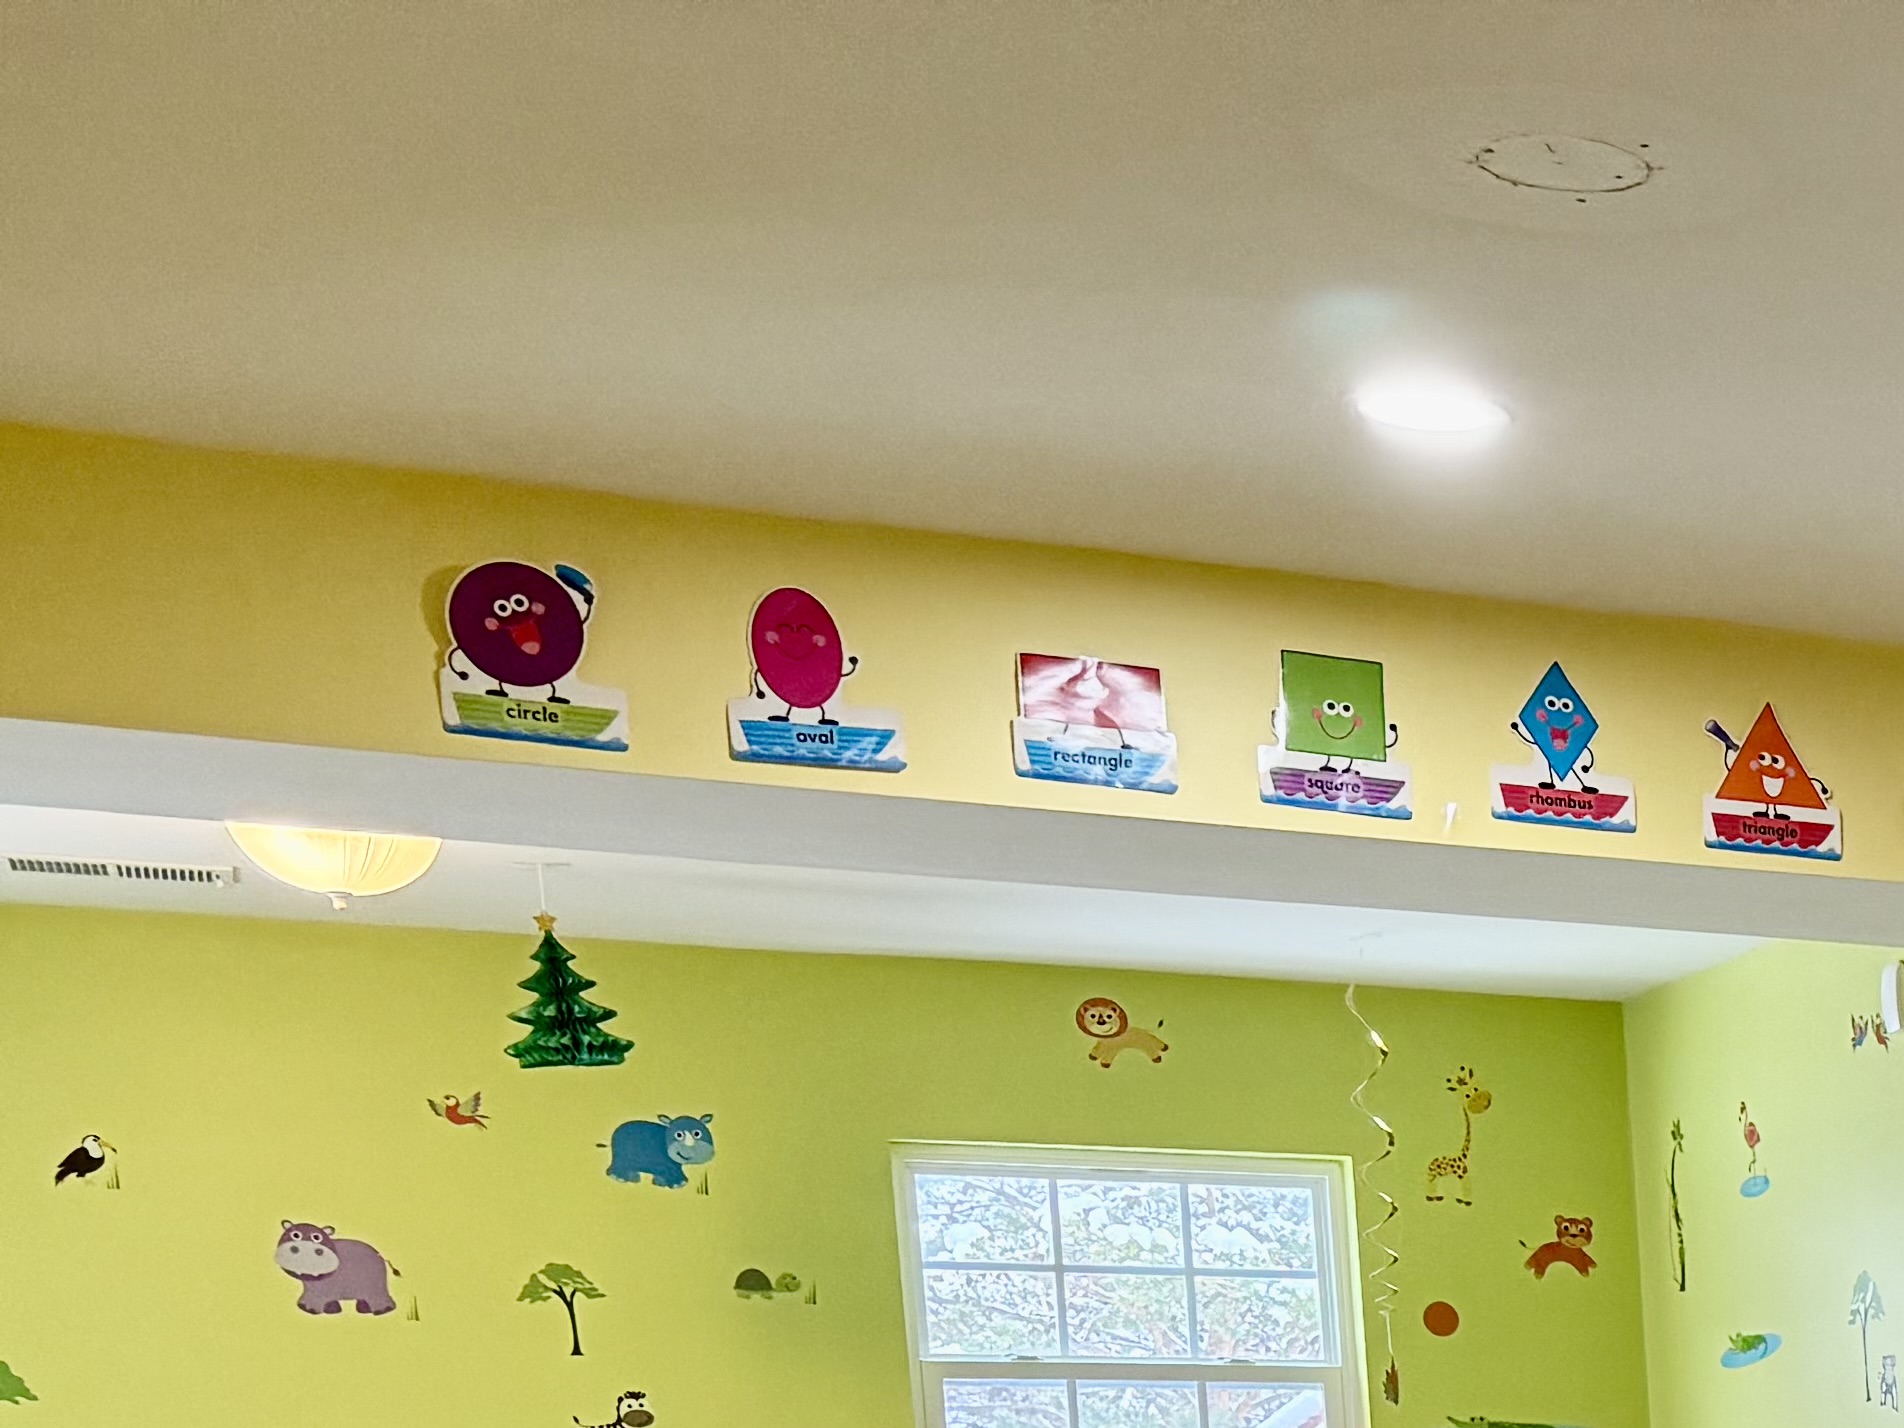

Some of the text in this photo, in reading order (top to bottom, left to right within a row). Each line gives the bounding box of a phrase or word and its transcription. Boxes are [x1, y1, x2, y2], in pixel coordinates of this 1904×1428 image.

[506, 706, 559, 723] circle
[796, 732, 834, 745] oval
[1053, 750, 1133, 771] rectangle
[1307, 777, 1361, 795] square
[1530, 791, 1594, 809] rhombus
[1743, 821, 1798, 841] triangle
